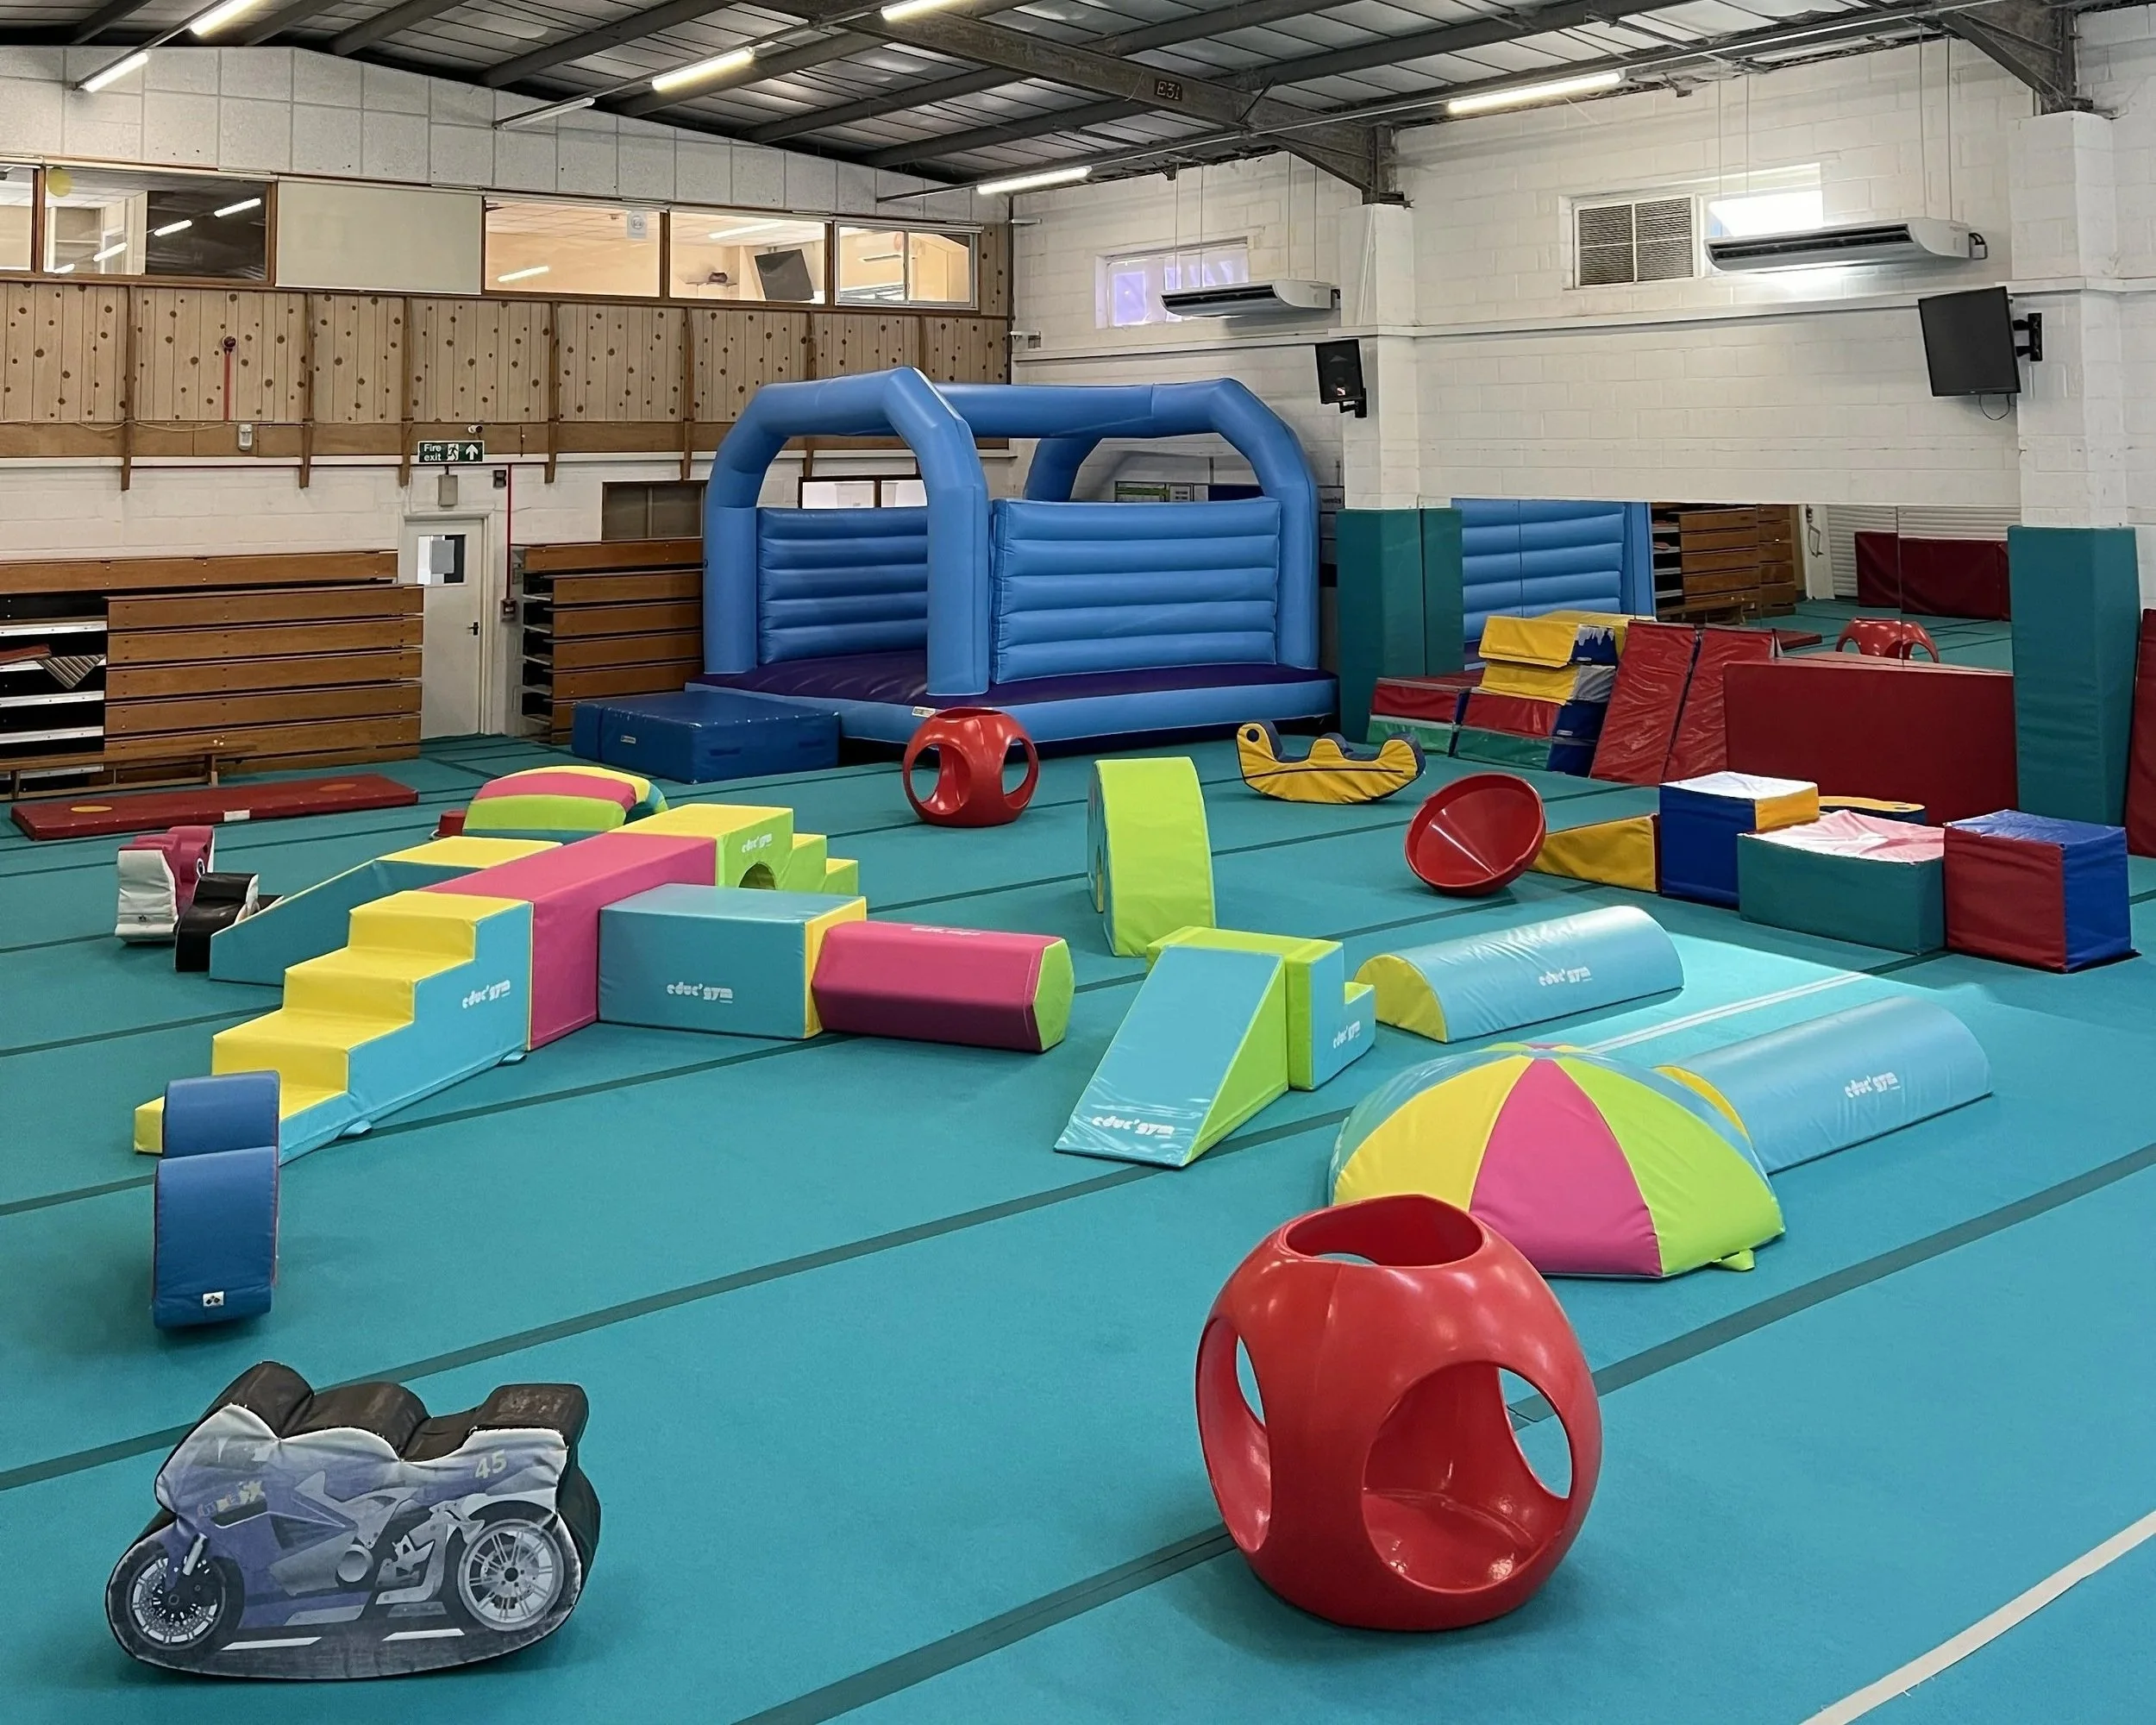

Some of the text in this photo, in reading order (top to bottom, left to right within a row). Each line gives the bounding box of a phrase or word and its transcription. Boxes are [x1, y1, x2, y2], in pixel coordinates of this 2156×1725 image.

[423, 443, 442, 453] Fire
[423, 453, 442, 461] exit
[474, 1449, 507, 1479] 45
